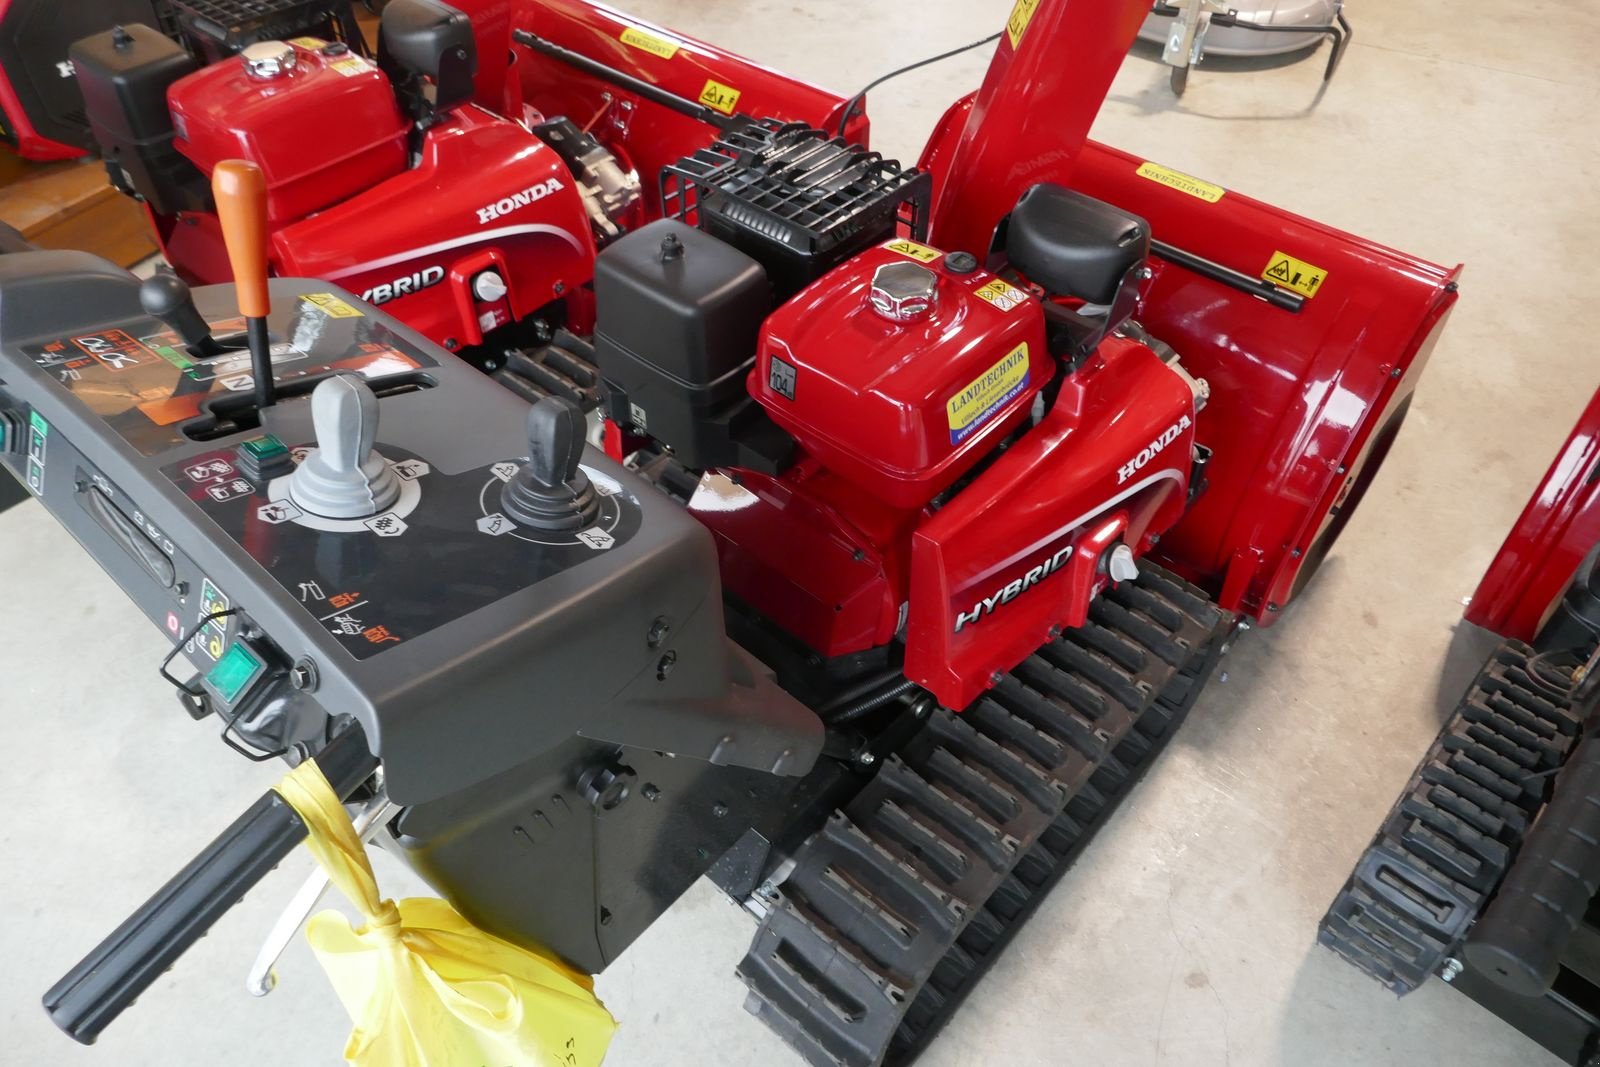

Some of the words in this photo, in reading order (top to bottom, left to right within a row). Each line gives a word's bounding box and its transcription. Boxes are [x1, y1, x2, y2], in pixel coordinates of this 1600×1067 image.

[476, 177, 565, 225] HONDA
[356, 264, 445, 305] BRID
[771, 371, 788, 395] 104
[951, 347, 1025, 414] LANDTECHNIK
[1117, 414, 1192, 486] HONDA
[954, 545, 1074, 633] HYBRID
